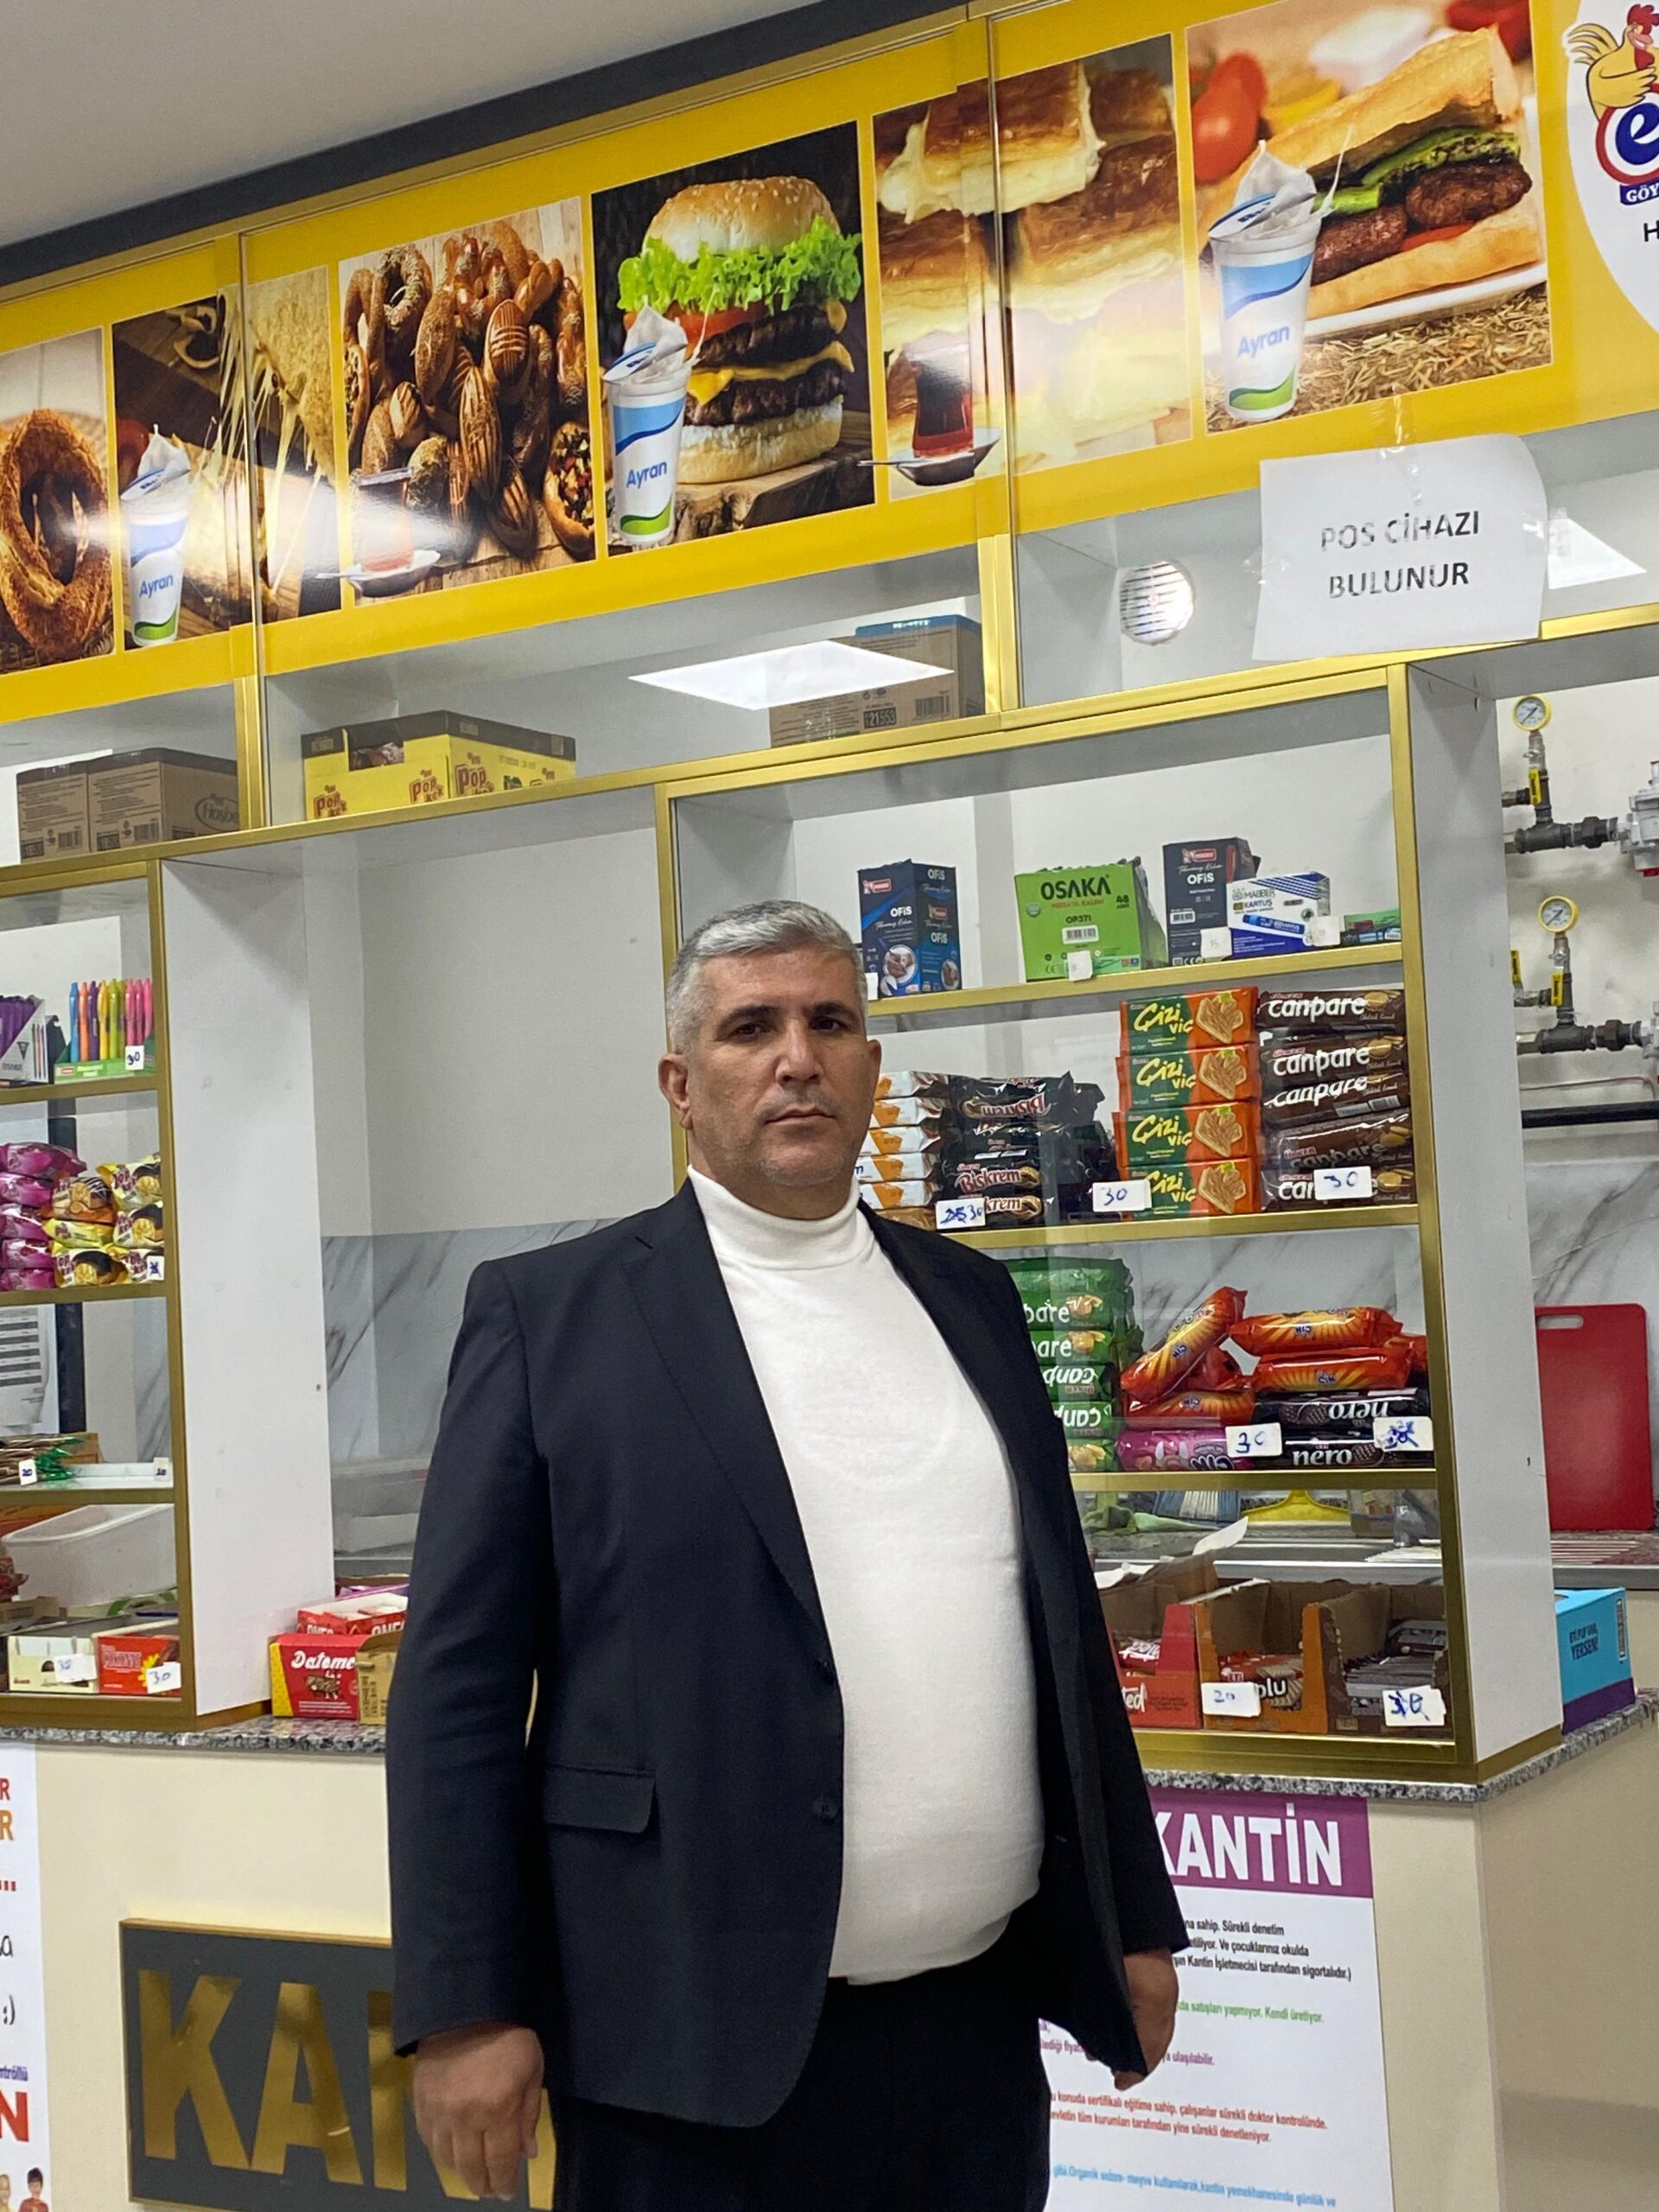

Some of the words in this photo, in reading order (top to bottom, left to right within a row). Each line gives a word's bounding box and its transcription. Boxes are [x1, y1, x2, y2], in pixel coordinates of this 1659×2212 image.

[1236, 326, 1290, 359] Ayran
[626, 461, 668, 490] Ayran
[1321, 522, 1375, 551] POS
[1384, 511, 1479, 544] CİHAZI
[138, 575, 174, 599] Ayran
[1329, 563, 1469, 599] BULUNUR
[1040, 875, 1111, 900] OSAKA
[1268, 996, 1367, 1023] canpare
[1273, 1046, 1370, 1077] canpare
[1272, 1076, 1368, 1107] canpare
[959, 1167, 1022, 1194] Biskrem
[985, 1196, 1023, 1214] krem
[1292, 1447, 1353, 1466] nero
[1252, 1923, 1285, 1936] denetim
[1187, 1955, 1214, 1967] Kantin
